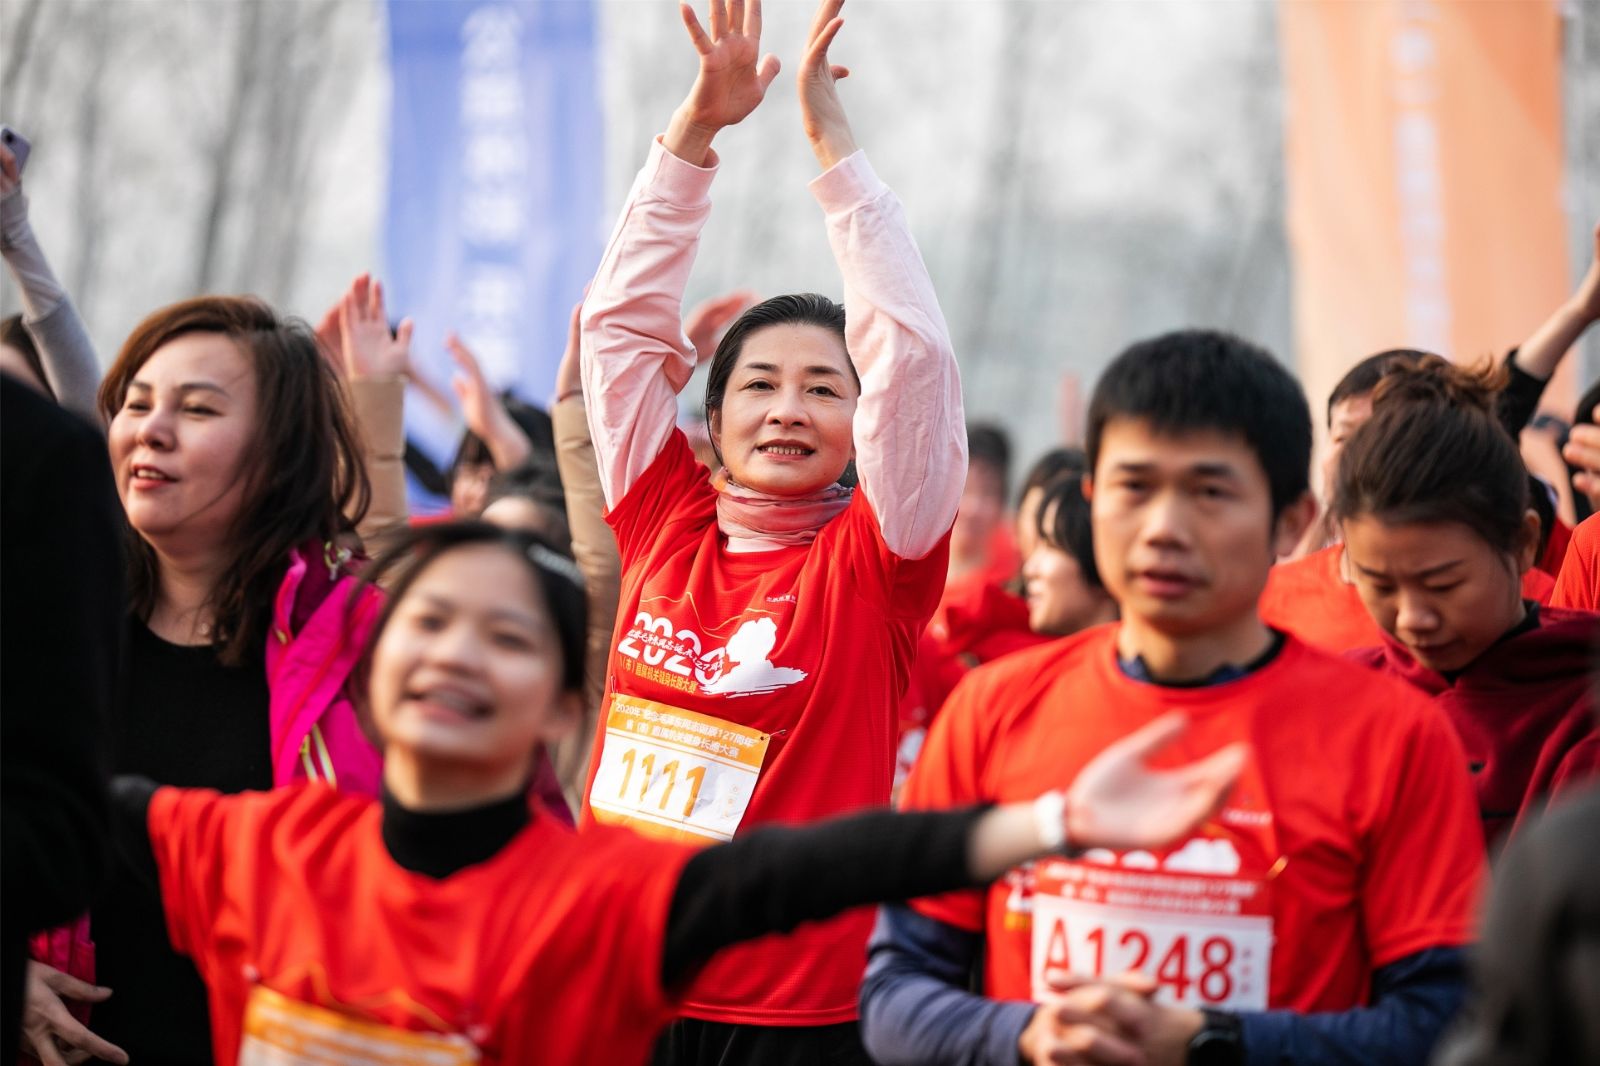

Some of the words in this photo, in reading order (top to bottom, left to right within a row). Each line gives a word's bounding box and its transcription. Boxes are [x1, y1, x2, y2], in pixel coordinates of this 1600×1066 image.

[617, 611, 726, 685] 2020
[618, 748, 707, 817] 1111
[1043, 917, 1235, 1004] A1248
